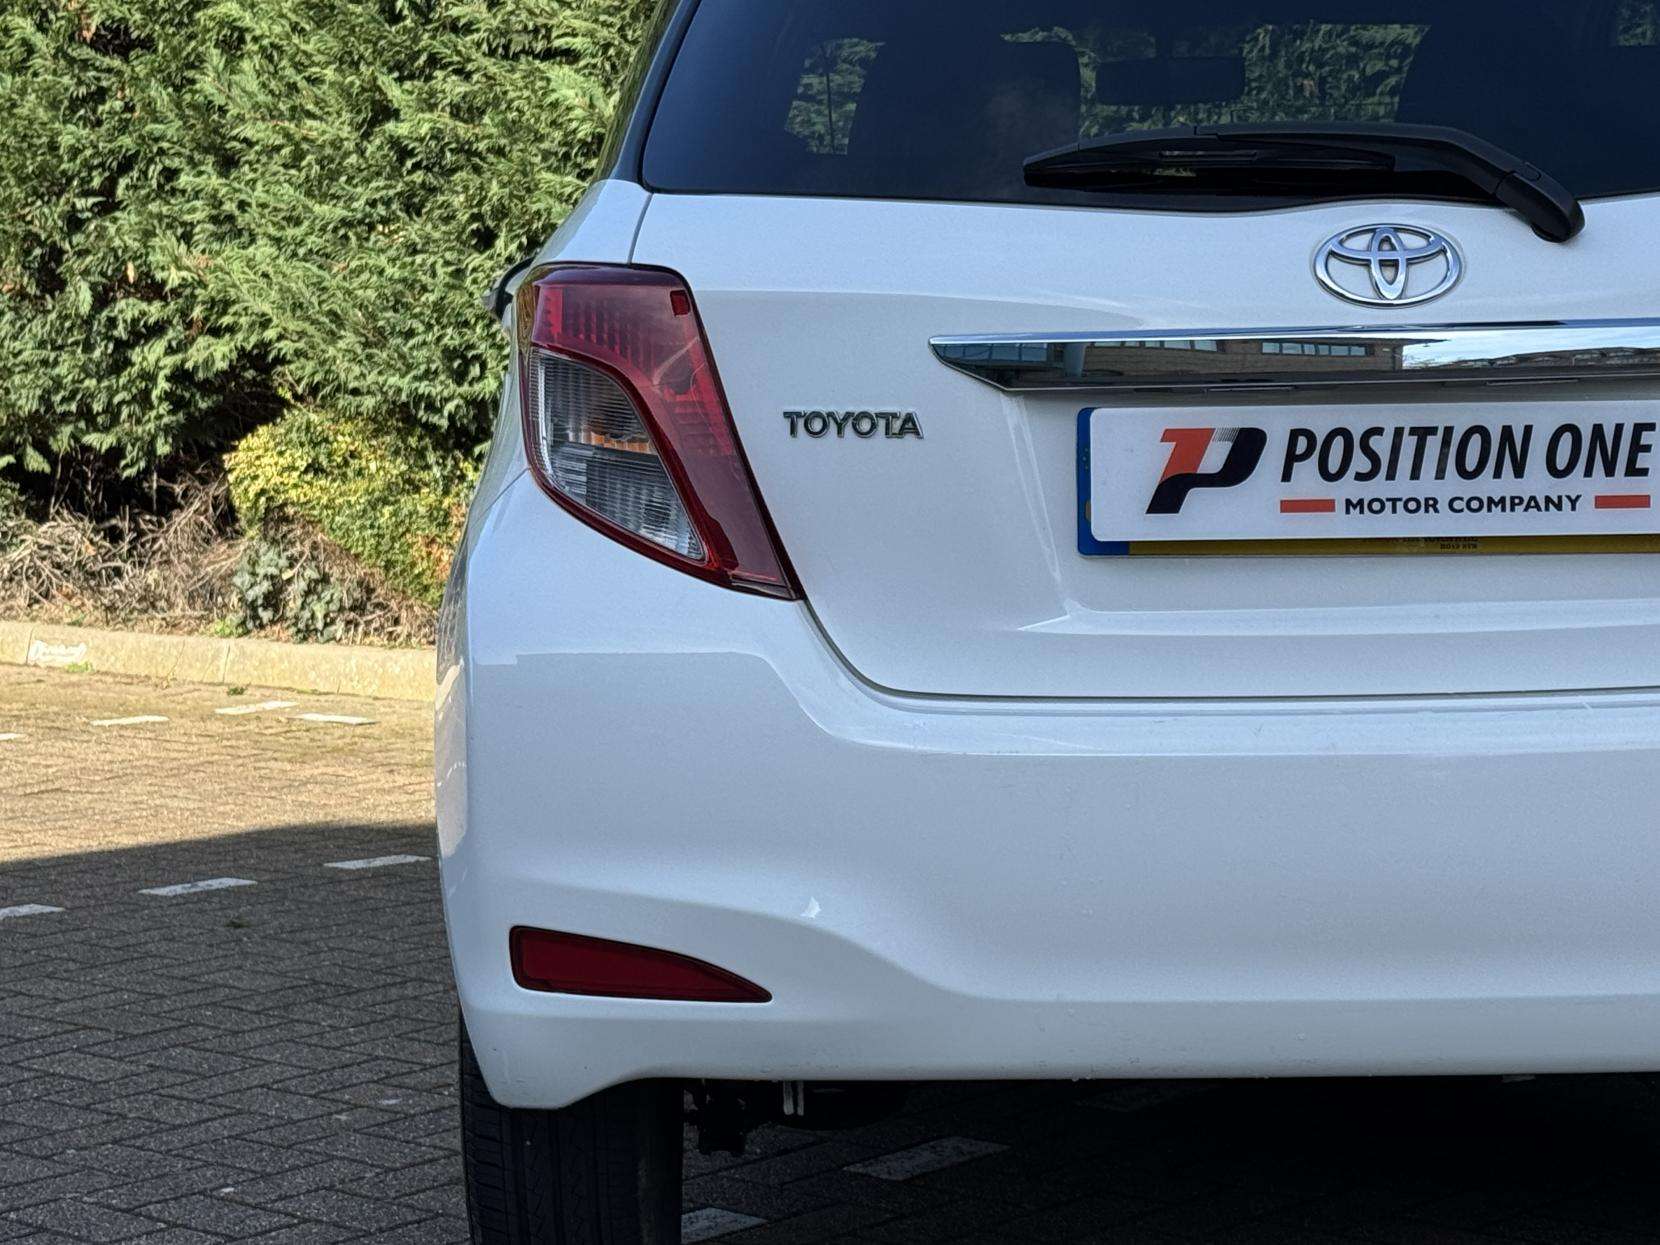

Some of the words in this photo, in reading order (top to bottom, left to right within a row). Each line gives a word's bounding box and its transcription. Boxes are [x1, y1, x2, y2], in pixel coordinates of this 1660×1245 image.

[783, 410, 924, 439] TOYOTA
[1280, 424, 1533, 482] POSITION
[1545, 422, 1656, 478] ONE
[1344, 497, 1440, 515] MOTOR
[1447, 494, 1583, 513] COMPANY
